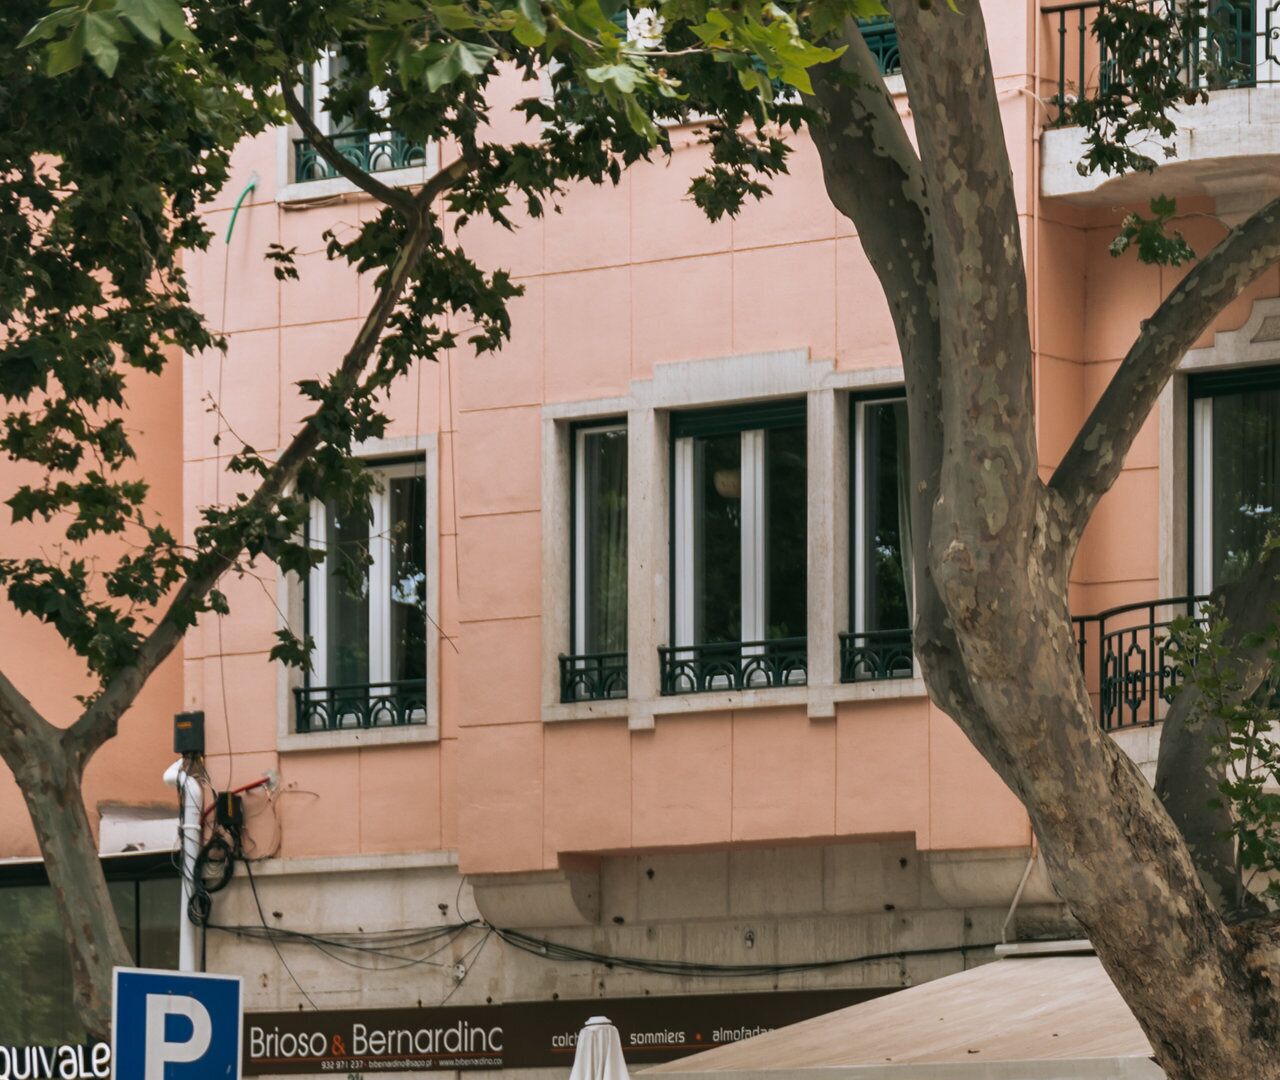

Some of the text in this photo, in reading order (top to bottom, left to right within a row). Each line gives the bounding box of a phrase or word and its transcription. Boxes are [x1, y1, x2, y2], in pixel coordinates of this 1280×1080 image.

[250, 1026, 328, 1058] Brioso
[331, 1033, 347, 1056] &
[630, 1030, 686, 1045] sommiers
